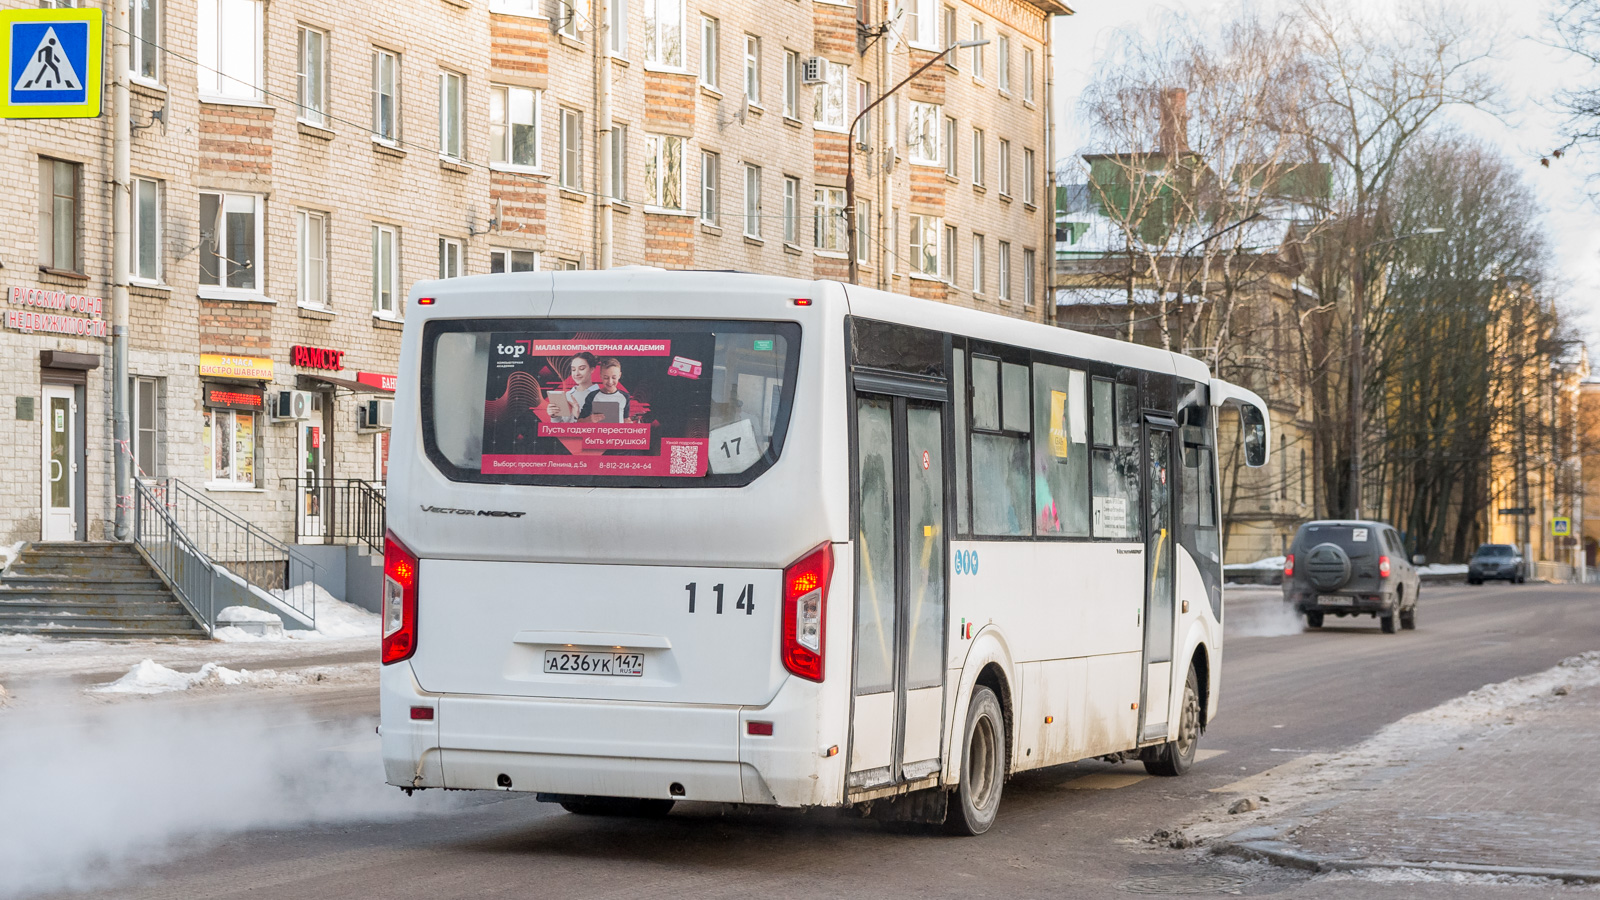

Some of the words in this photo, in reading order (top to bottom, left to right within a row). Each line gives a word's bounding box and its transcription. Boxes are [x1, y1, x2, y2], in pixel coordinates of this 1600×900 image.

[13, 287, 66, 310] РУССКИЙ
[69, 295, 102, 318] ФОНД
[9, 311, 107, 337] НЕДВИЖИМОСТИ
[496, 343, 526, 358] top
[623, 344, 665, 352] АКАДЕМИЯ
[221, 357, 231, 366] 24
[232, 358, 253, 368] ЧАСА
[294, 345, 345, 371] РАМСЕС
[201, 365, 232, 375] БИСТРО
[233, 367, 273, 378] ШАВЕРМА
[542, 425, 566, 434] Пусть
[566, 426, 596, 434] гаджет
[597, 427, 648, 435] перестанет
[584, 436, 604, 445] быть
[605, 437, 647, 447] игрушкой
[720, 436, 742, 459] 17
[518, 461, 547, 469] проспект
[599, 461, 652, 470] 8-812-214-24-64
[549, 654, 611, 673] А236УК
[615, 654, 639, 669] 147
